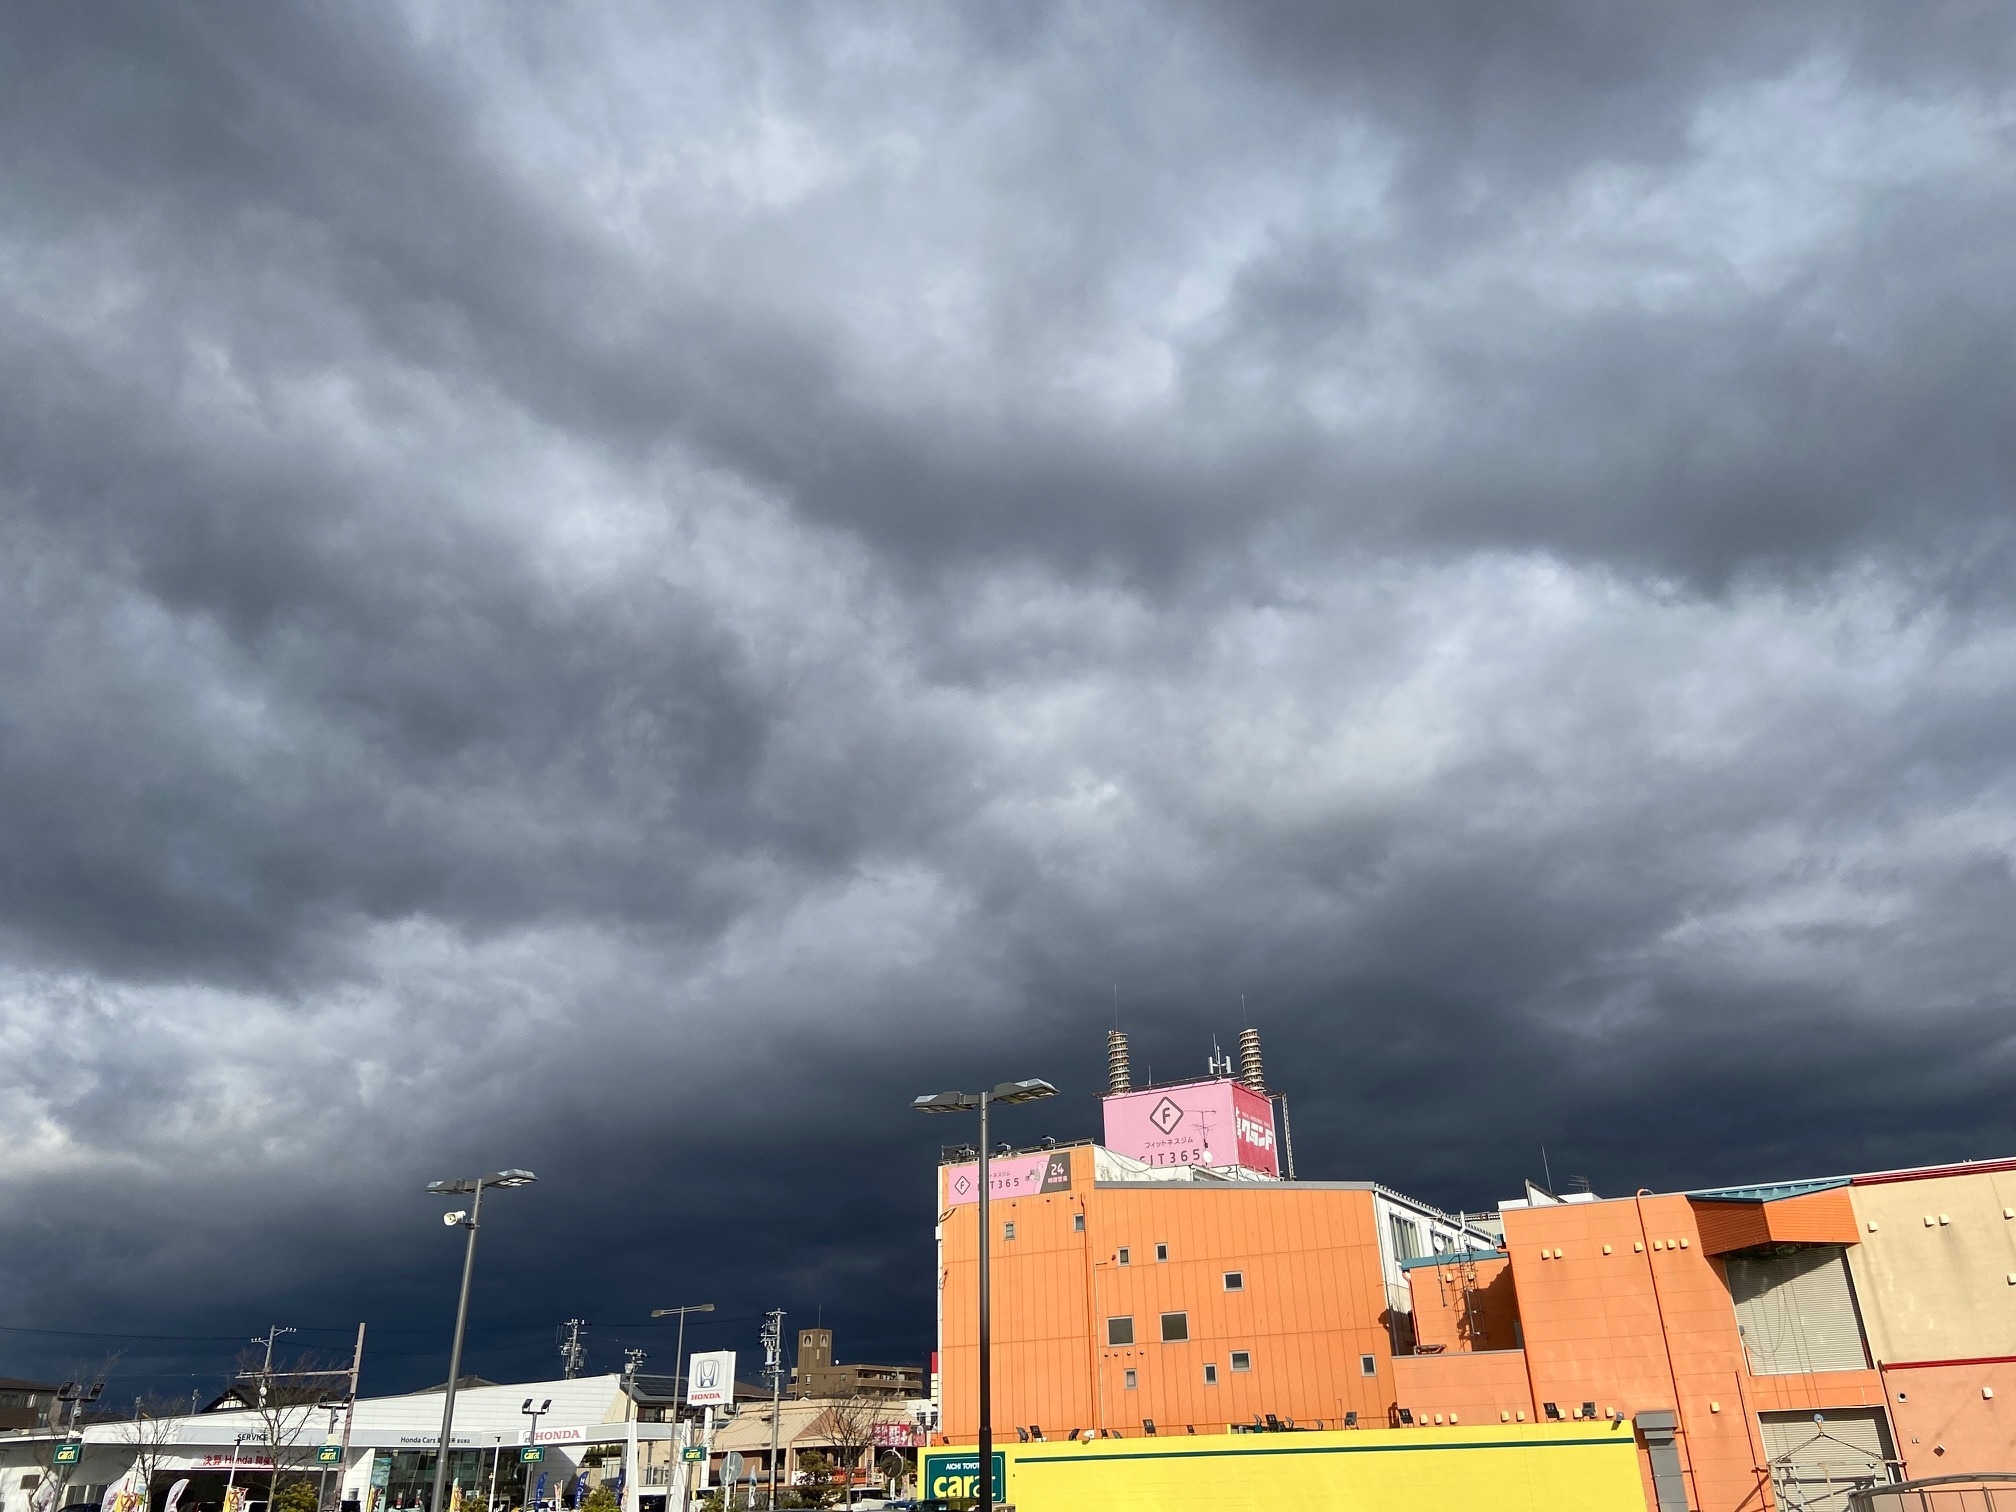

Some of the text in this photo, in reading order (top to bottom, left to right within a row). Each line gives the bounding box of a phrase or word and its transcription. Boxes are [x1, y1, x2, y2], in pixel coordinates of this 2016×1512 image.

[1145, 1137, 1193, 1149] フィットネスジム
[1051, 1163, 1064, 1176] 24
[691, 1393, 721, 1401] HONDA
[237, 1433, 268, 1441] SERVICE
[534, 1430, 580, 1441] HONDA
[945, 1462, 980, 1471] AICHI TOYOT
